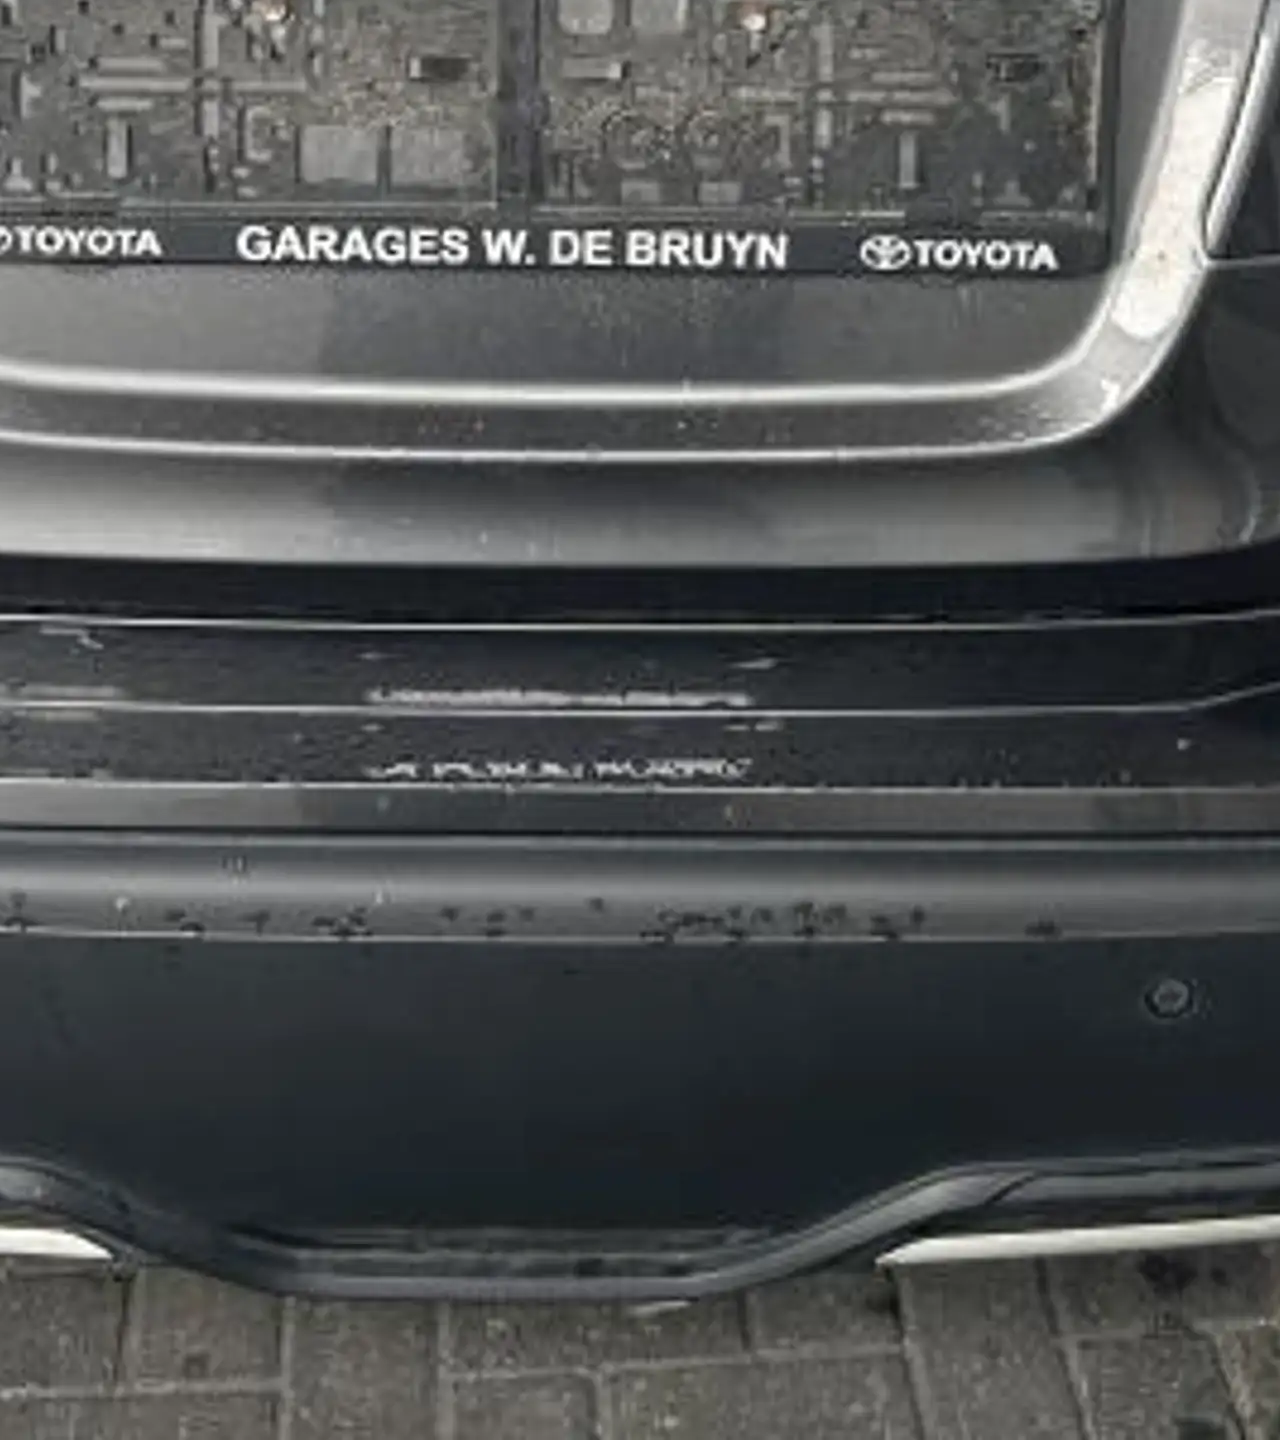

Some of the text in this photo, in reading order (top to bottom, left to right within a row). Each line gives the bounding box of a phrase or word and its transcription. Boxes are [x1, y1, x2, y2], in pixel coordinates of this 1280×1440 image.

[14, 224, 1060, 271] TOYOTA GARAGES W. DE BRUYN TOYOTA
